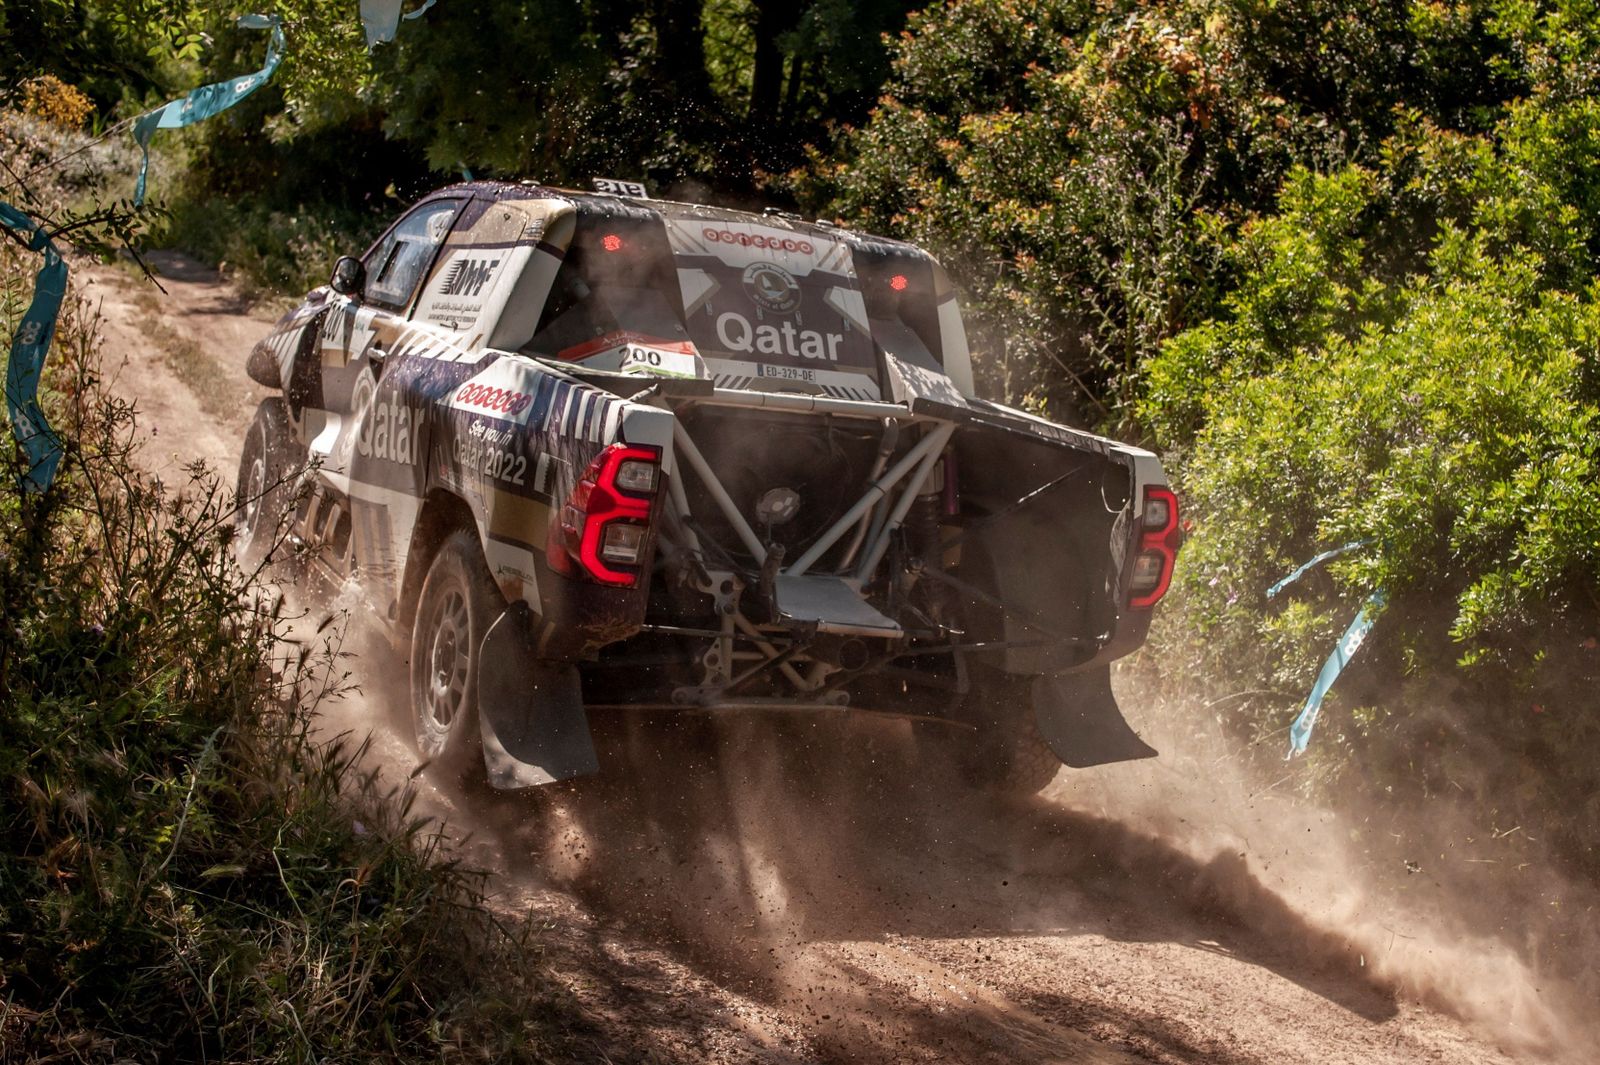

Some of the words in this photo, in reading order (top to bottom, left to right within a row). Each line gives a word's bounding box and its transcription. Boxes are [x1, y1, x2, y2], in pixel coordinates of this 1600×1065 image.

[619, 346, 661, 368] 200
[716, 312, 843, 361] Qatar
[356, 390, 426, 466] Qatar
[469, 420, 486, 437] See
[481, 427, 502, 442] you
[500, 430, 513, 446] in
[453, 435, 483, 471] Qatar
[484, 447, 527, 486] 2022
